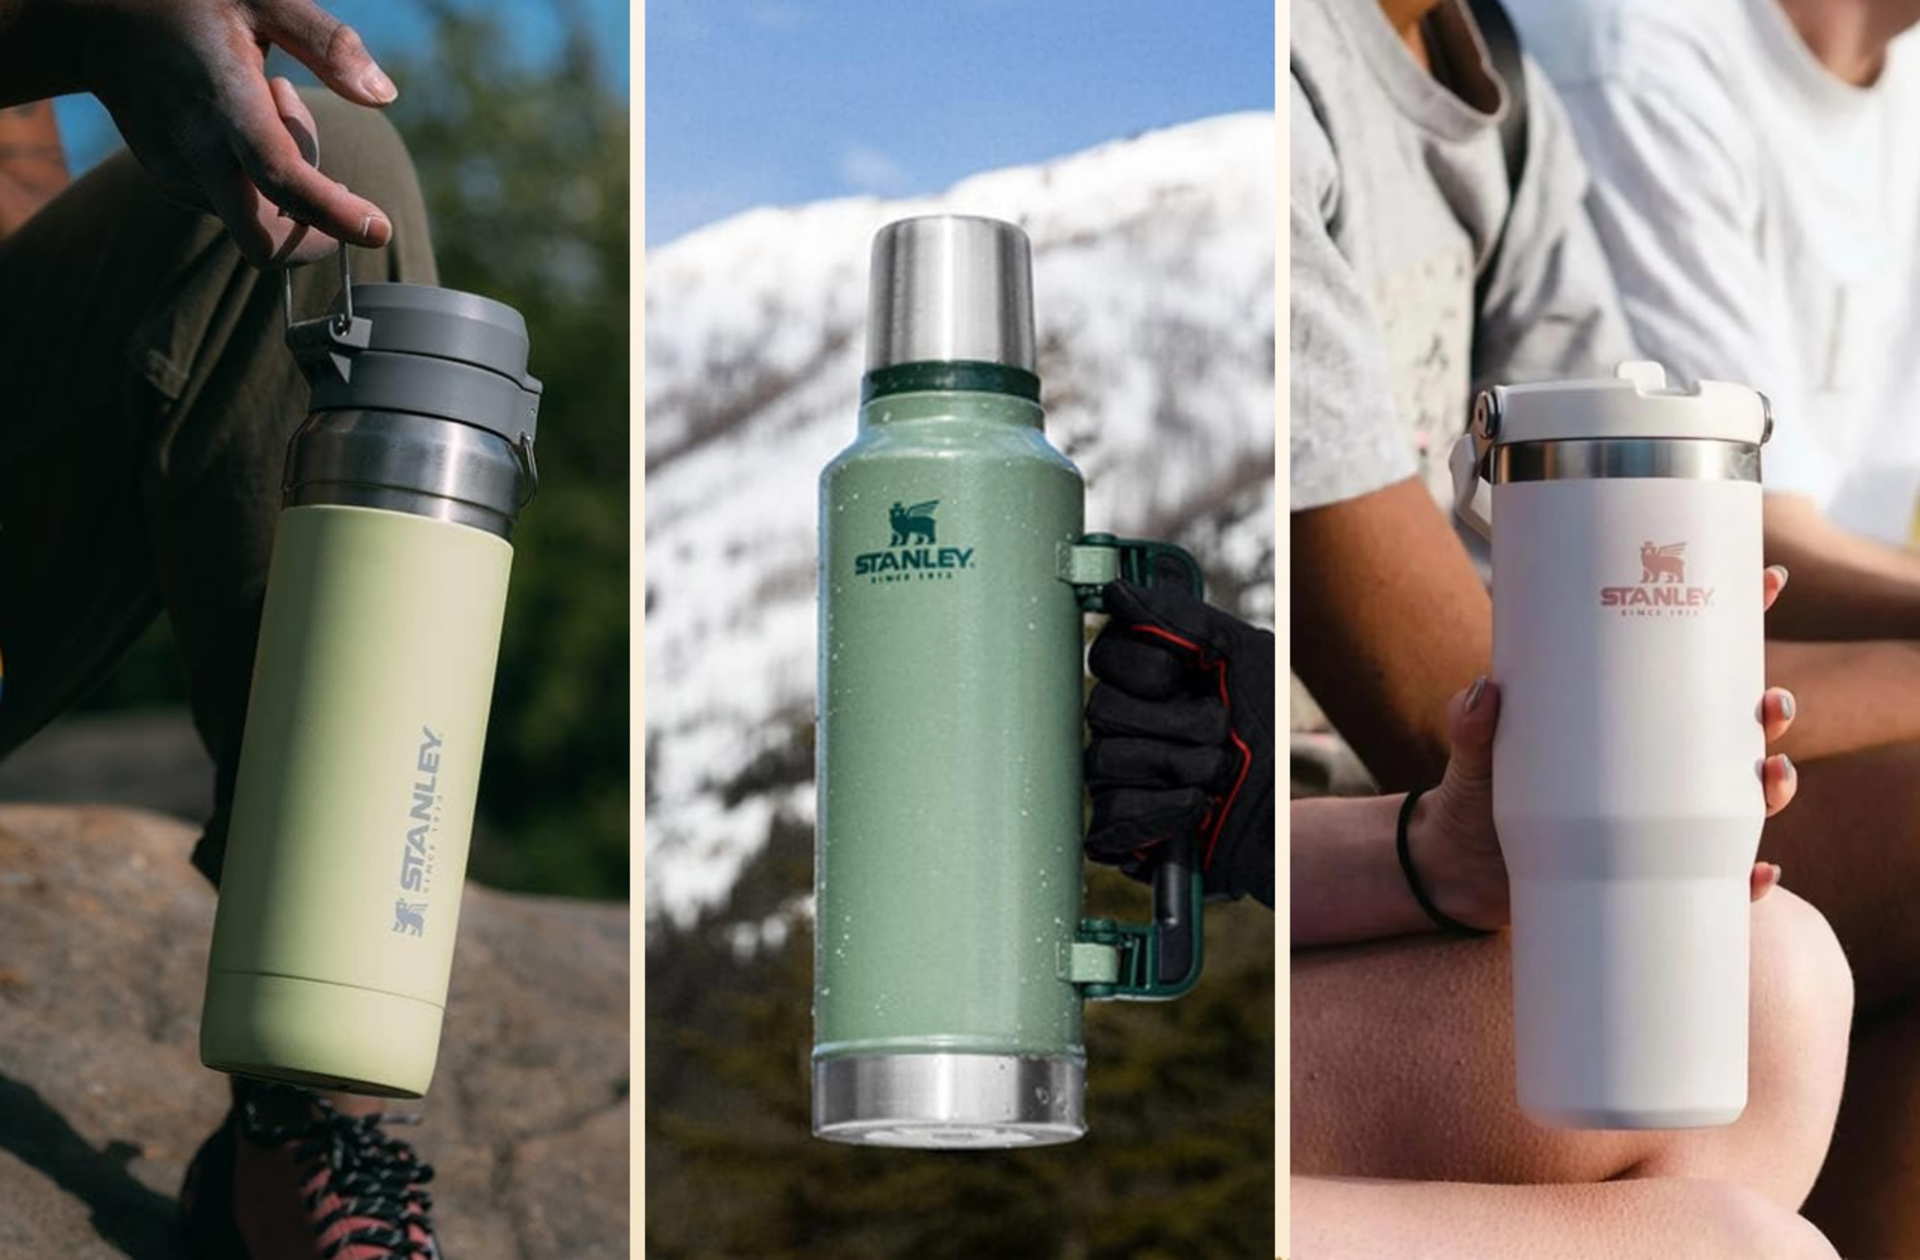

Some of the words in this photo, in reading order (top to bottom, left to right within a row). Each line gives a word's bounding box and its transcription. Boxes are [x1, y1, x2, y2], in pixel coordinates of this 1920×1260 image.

[855, 548, 973, 575] STANLEY
[1601, 586, 1715, 606] STANLEY
[400, 725, 442, 892] STANLEY
